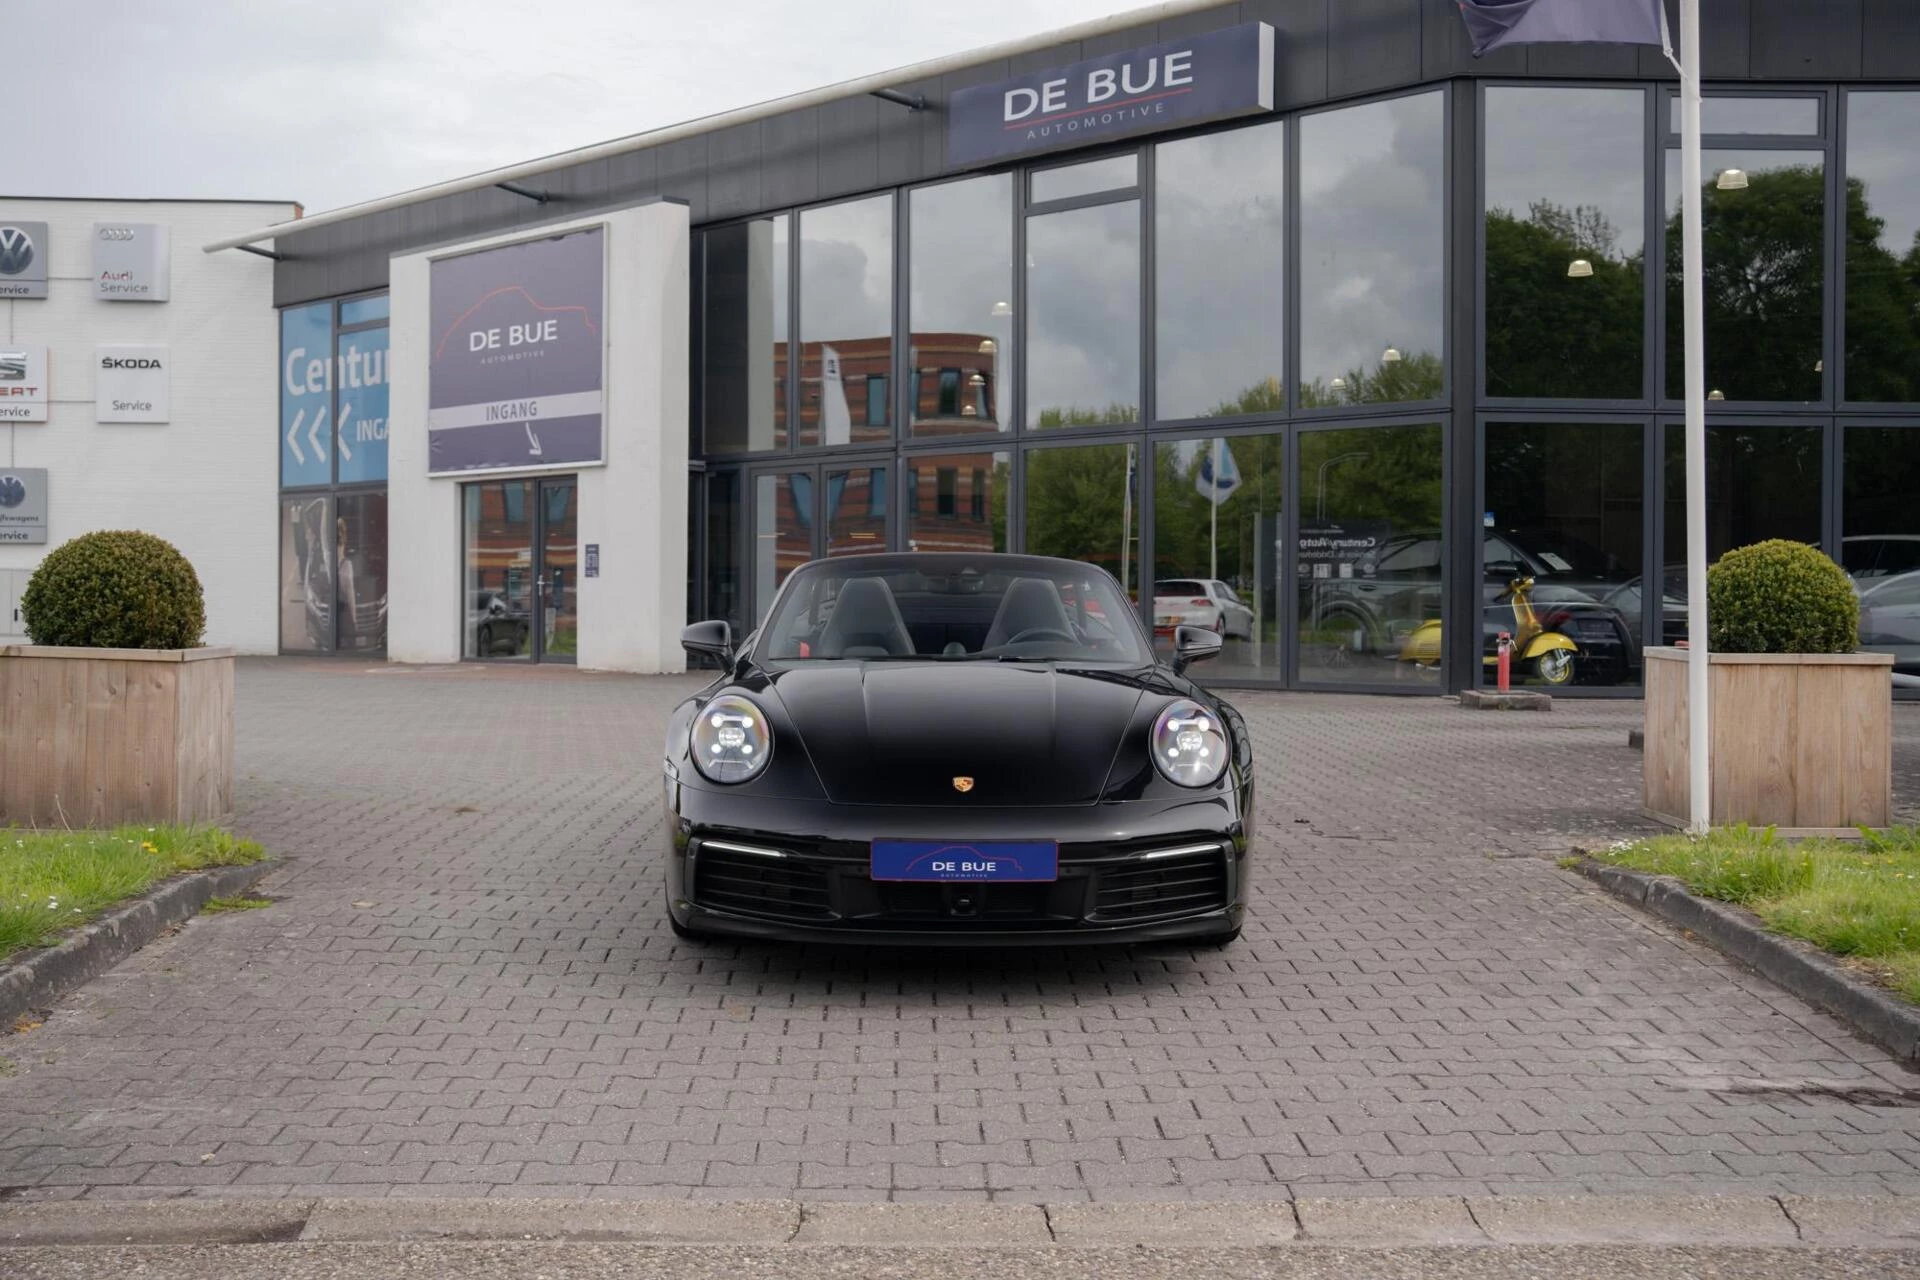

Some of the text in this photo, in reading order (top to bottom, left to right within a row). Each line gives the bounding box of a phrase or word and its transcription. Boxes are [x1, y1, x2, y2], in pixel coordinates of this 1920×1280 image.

[1004, 50, 1193, 122] DE BUE
[1026, 102, 1165, 140] AUTOMOTIVE
[101, 271, 133, 281] Audi
[100, 283, 149, 293] Service
[469, 319, 558, 352] DE BUE
[101, 356, 162, 369] ŠKODA
[480, 350, 545, 364] AUTOMOTIVE
[112, 400, 152, 411] Service
[486, 400, 538, 421] INGANG
[932, 861, 997, 872] DE BUE
